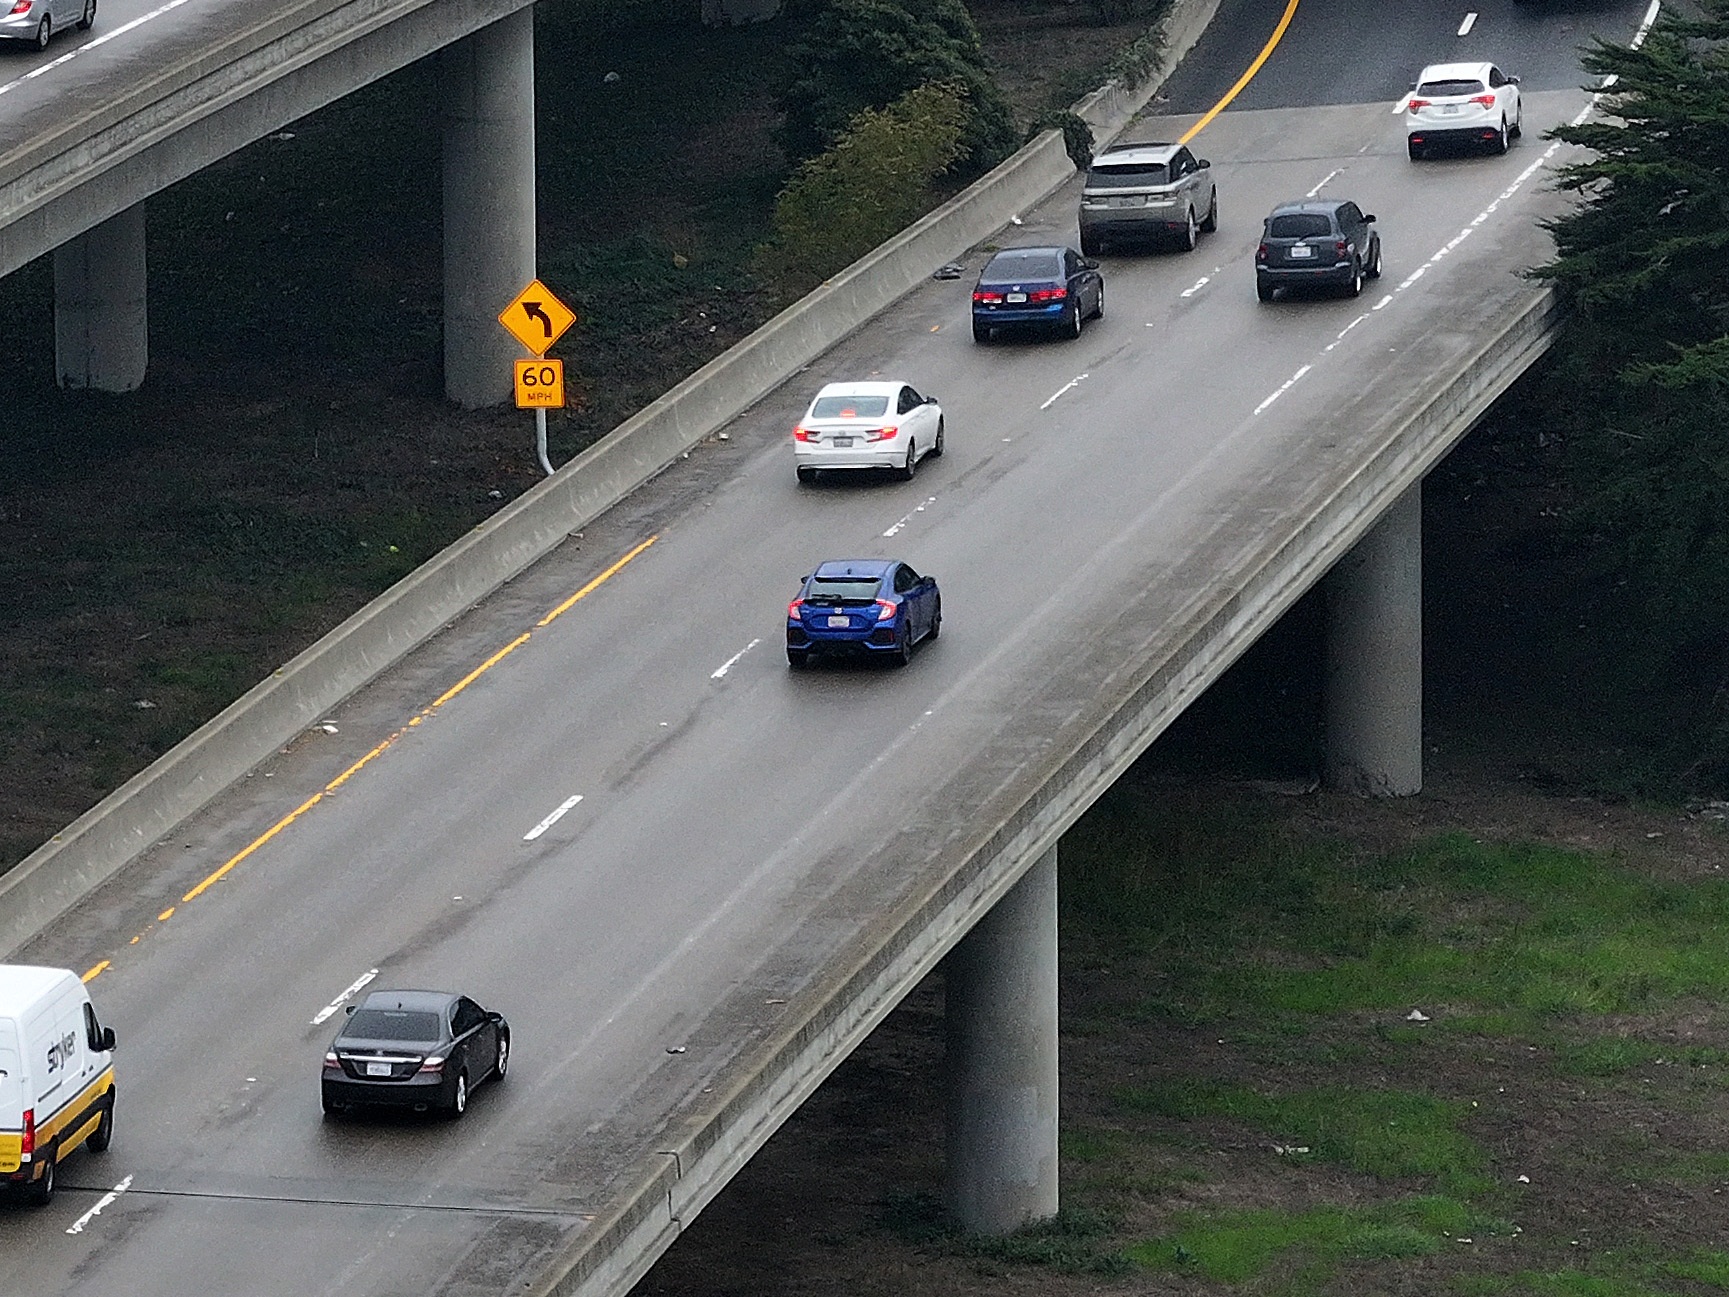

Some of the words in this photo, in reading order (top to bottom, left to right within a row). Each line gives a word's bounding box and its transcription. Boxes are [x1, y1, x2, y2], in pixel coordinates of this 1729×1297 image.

[522, 366, 556, 387] 60
[527, 392, 553, 402] MPH
[48, 1030, 77, 1074] stryker
